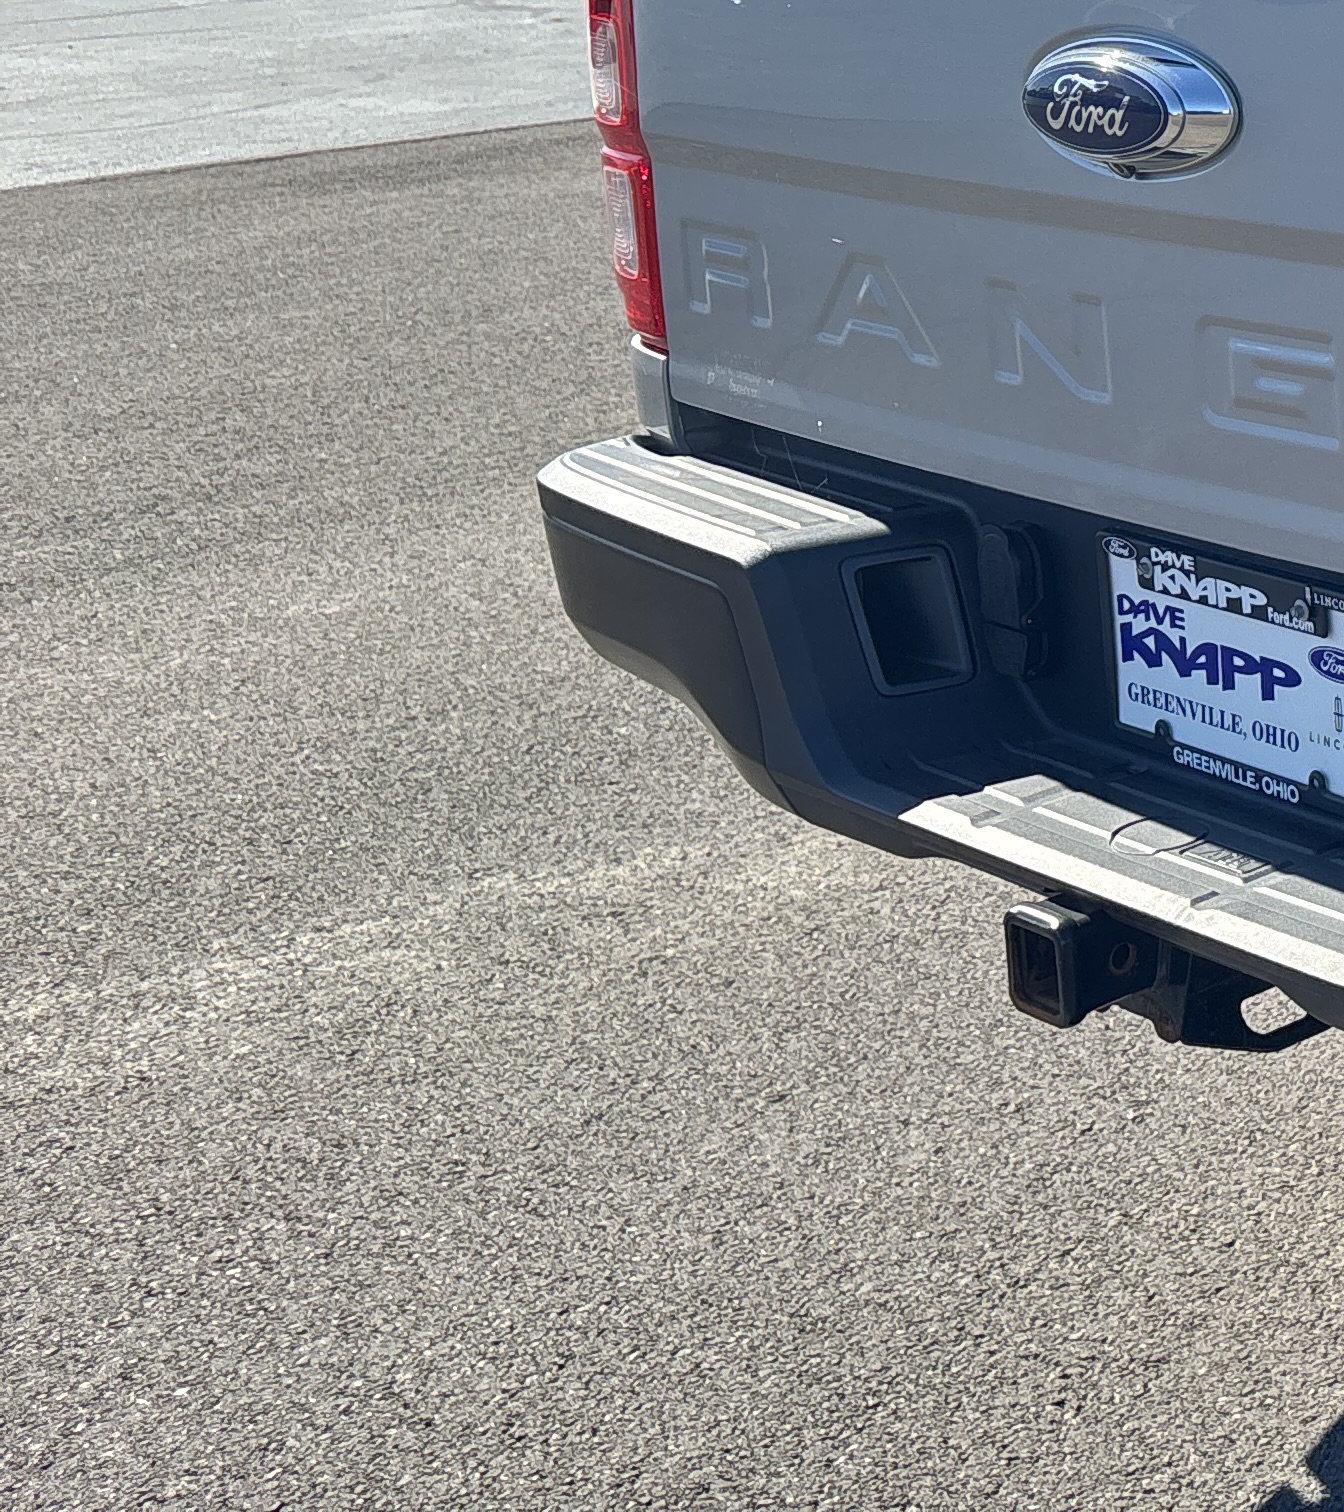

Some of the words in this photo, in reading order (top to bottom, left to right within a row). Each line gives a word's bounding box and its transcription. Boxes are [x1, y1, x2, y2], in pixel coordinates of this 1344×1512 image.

[1046, 73, 1130, 137] Ford
[1109, 539, 1129, 557] Ford
[1150, 546, 1195, 571] DAVE
[1117, 593, 1186, 631] DAVE
[1152, 565, 1267, 614] KNAPP
[1267, 606, 1315, 634] Ford.com
[1119, 622, 1302, 701] KNAPP
[1127, 681, 1248, 741] GREENVILLE,
[1251, 720, 1300, 753] OHIO
[1173, 746, 1259, 790] GREENVILLE,
[1262, 776, 1300, 804] OHIO
